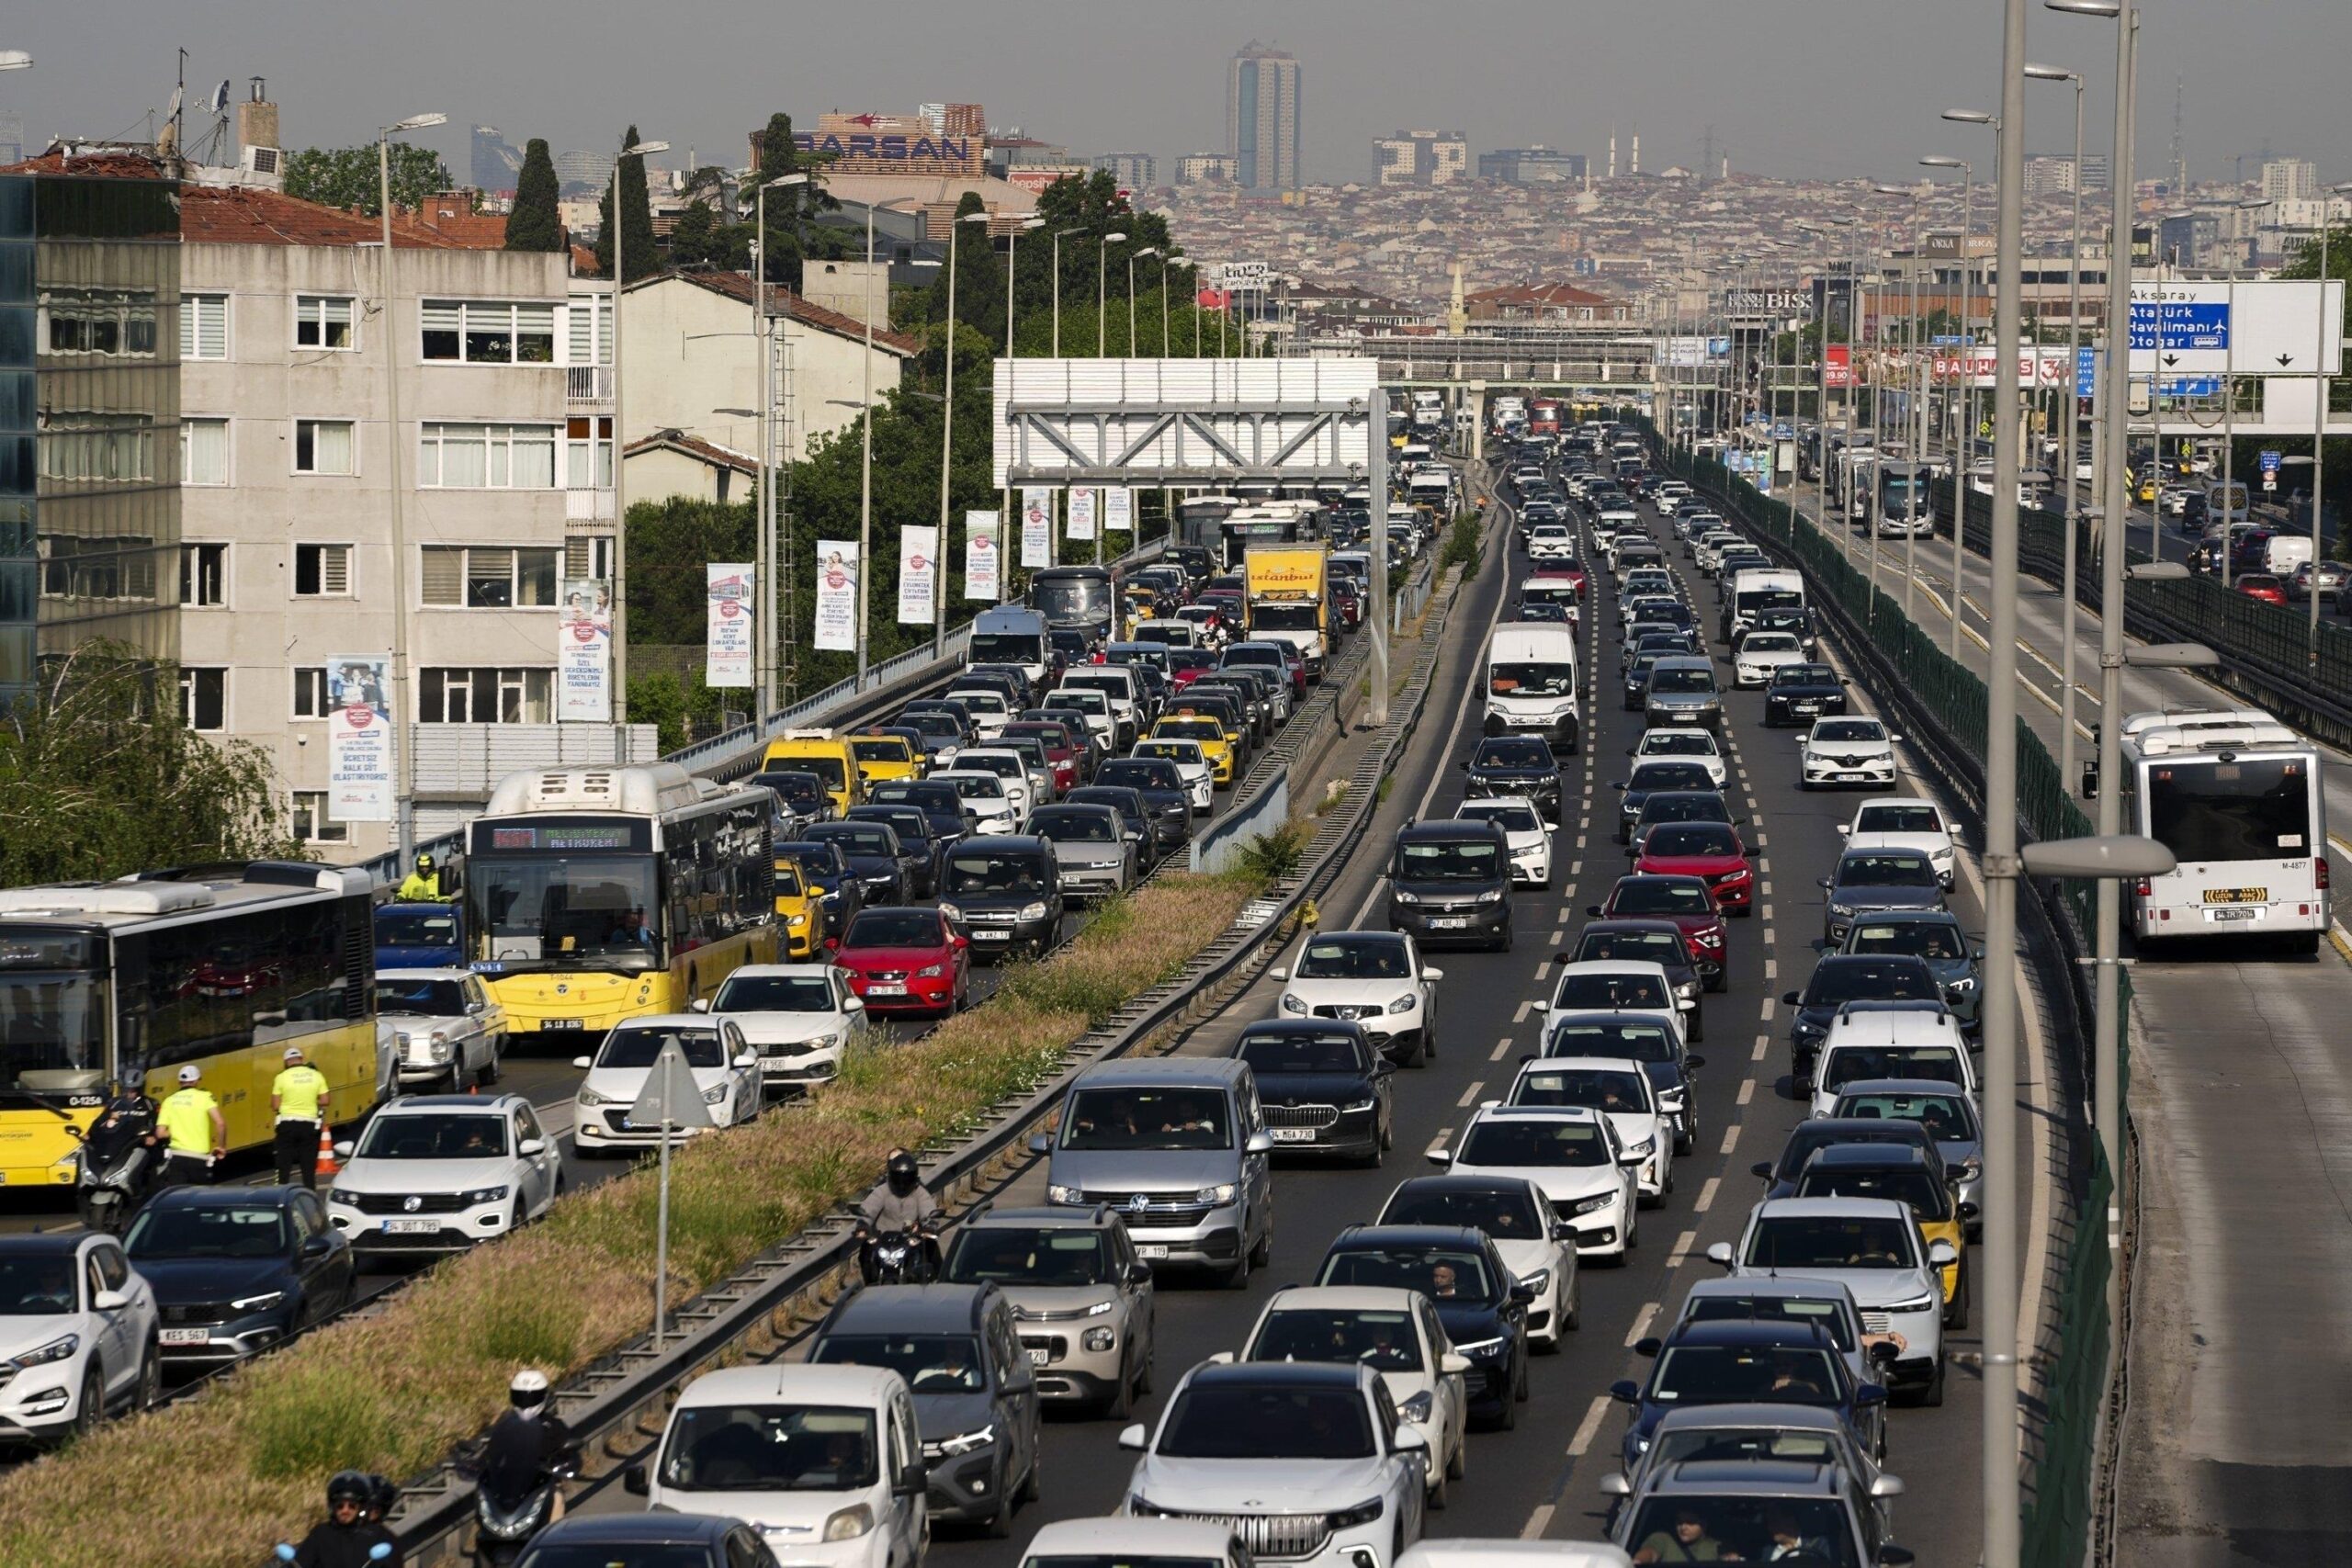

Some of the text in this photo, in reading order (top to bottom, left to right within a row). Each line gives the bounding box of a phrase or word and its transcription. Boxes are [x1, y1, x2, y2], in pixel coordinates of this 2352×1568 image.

[1932, 239, 1954, 249] ORKA
[2130, 289, 2197, 302] Aksaray
[2130, 307, 2193, 319] Atatürk
[1935, 360, 2031, 374] BAUHS
[1270, 1130, 1312, 1138] 34 MGA 730
[1153, 1246, 1166, 1256] 119
